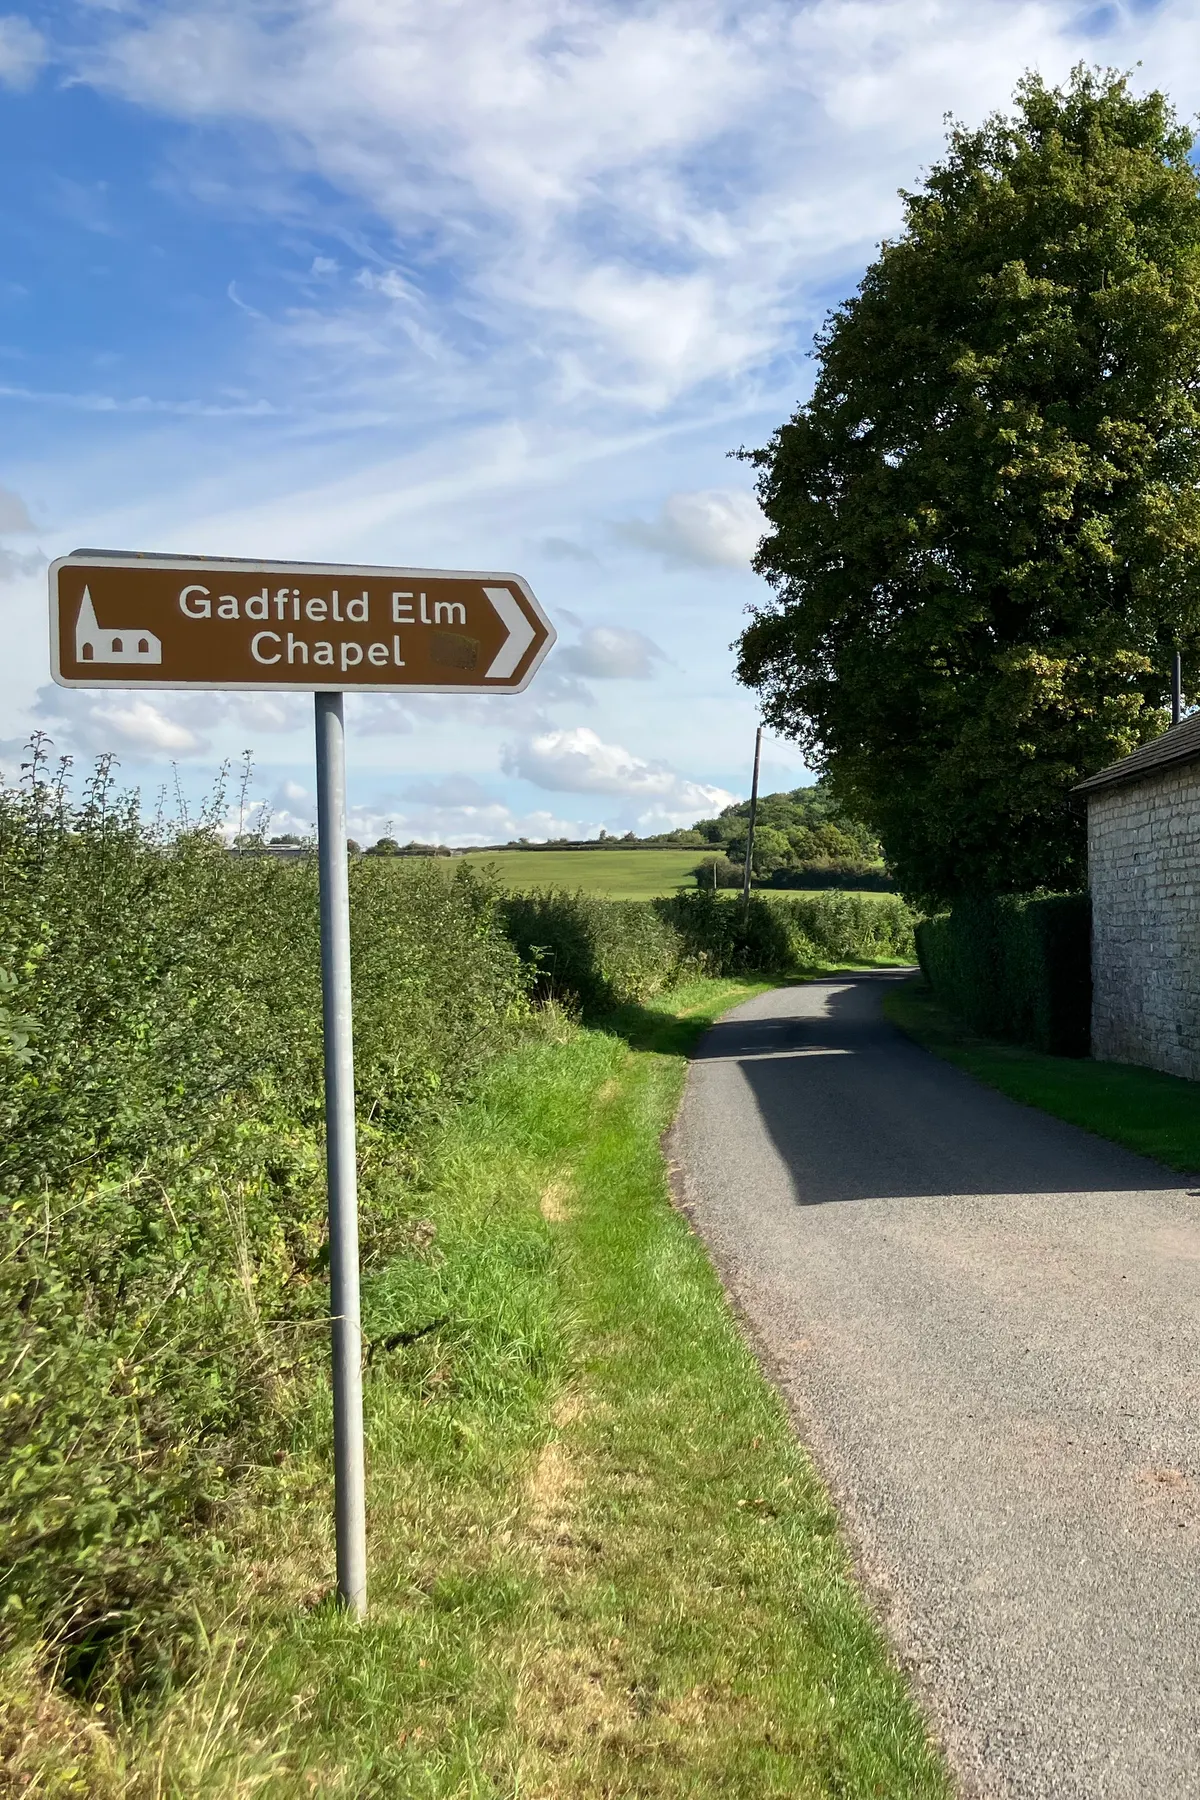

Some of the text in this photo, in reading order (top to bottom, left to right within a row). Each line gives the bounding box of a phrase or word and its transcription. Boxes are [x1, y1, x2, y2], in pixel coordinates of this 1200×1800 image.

[179, 584, 466, 625] Gadfield Elm
[251, 631, 406, 672] Chapel
